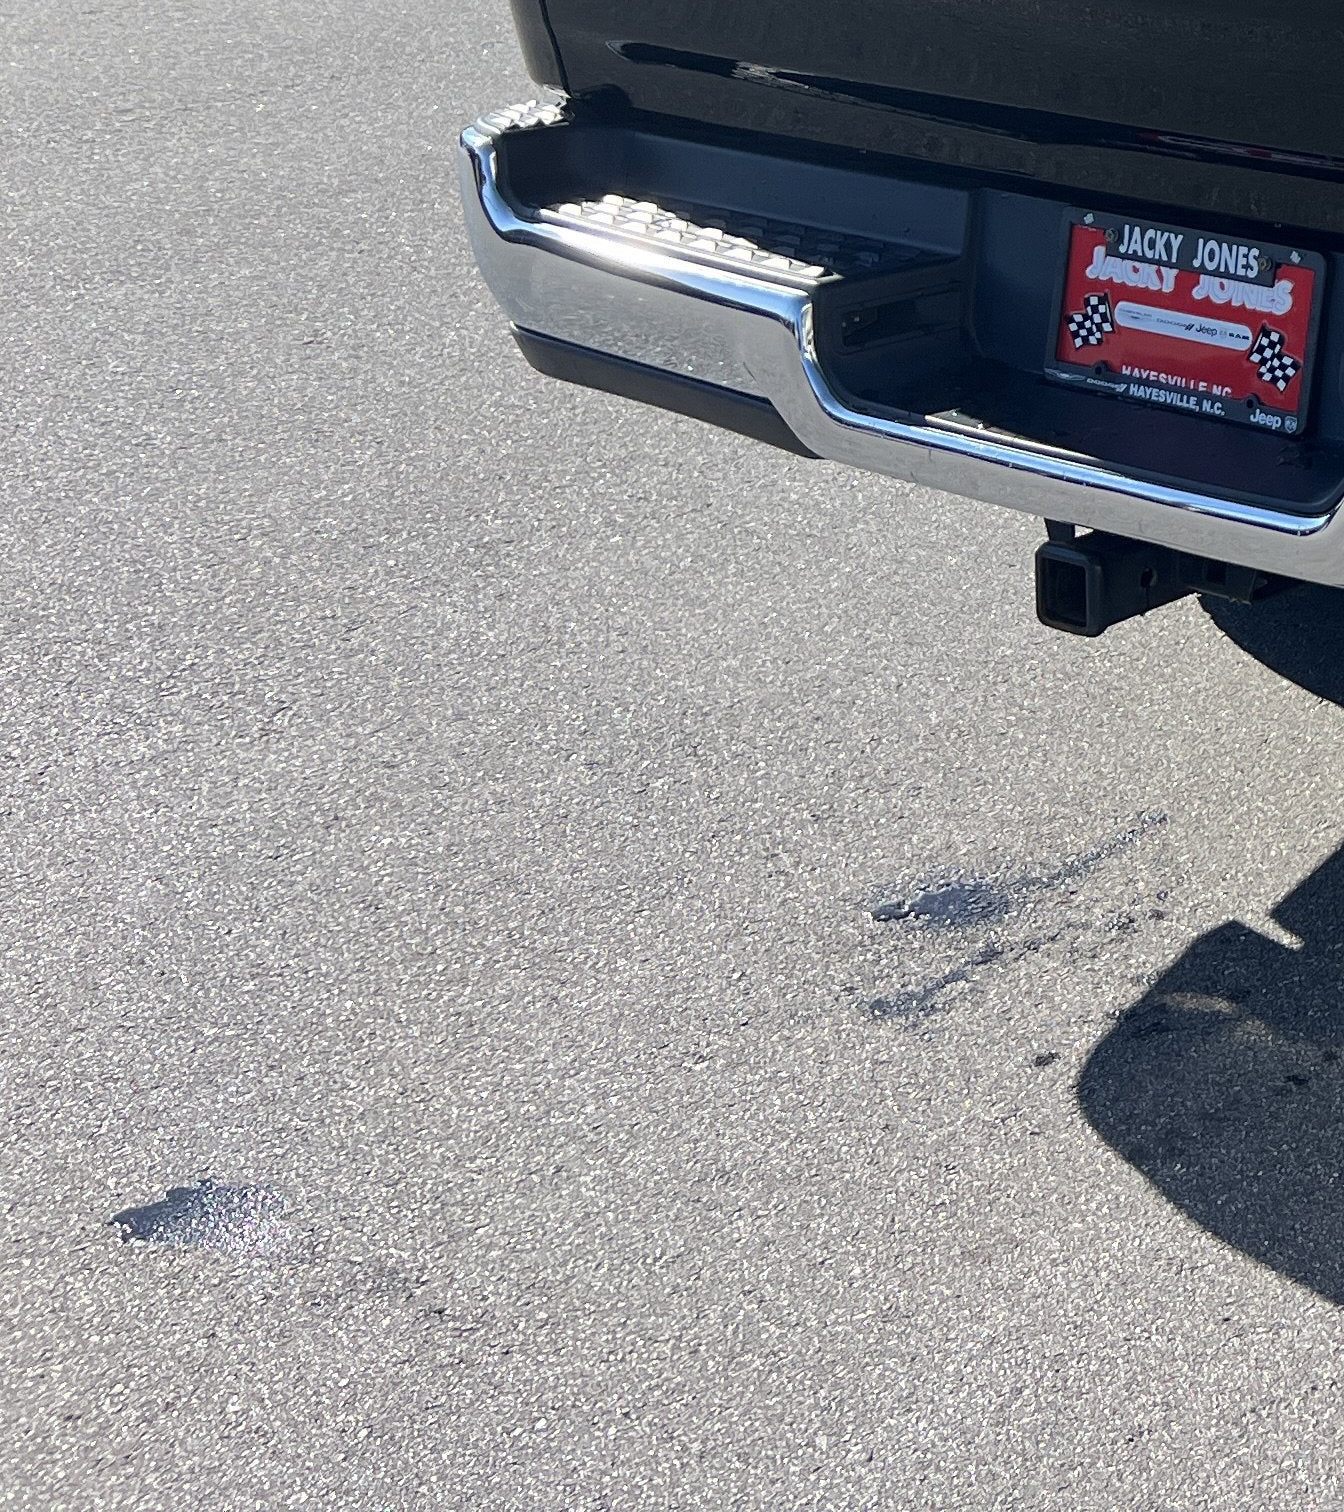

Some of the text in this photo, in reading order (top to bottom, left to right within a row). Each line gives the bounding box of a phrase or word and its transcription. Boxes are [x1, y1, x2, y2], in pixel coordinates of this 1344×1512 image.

[1118, 224, 1260, 278] JACKY JONES
[1086, 245, 1294, 316] JACKY JONES
[1195, 323, 1218, 337] Jeep
[1128, 383, 1200, 412] HAYESVILLE,
[1202, 399, 1226, 416] N.C.
[1249, 408, 1282, 429] Jeep
